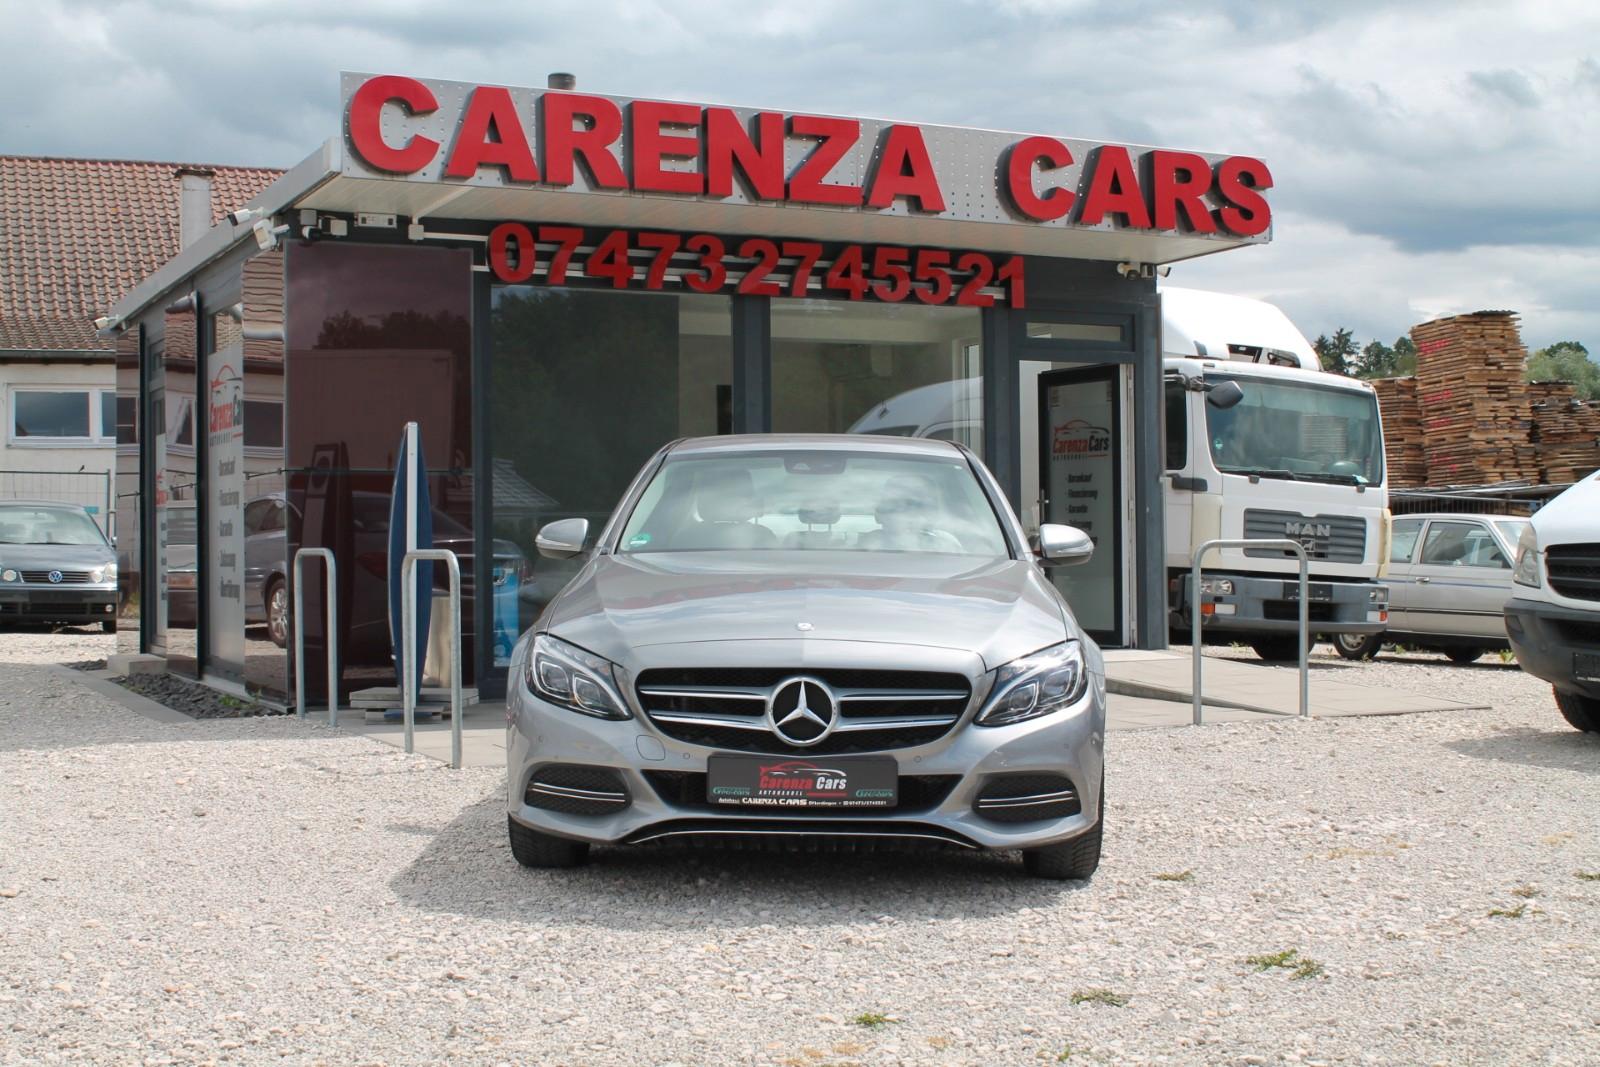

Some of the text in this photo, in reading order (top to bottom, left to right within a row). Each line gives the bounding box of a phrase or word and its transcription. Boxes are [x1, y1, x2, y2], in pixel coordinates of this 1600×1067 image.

[348, 74, 1274, 237] CARENZA CARS
[1088, 434, 1109, 452] Cars
[1286, 522, 1330, 536] MAN
[759, 775, 848, 790] Carenza Cars
[742, 797, 777, 805] CARENZA
[778, 798, 807, 806] CARS
